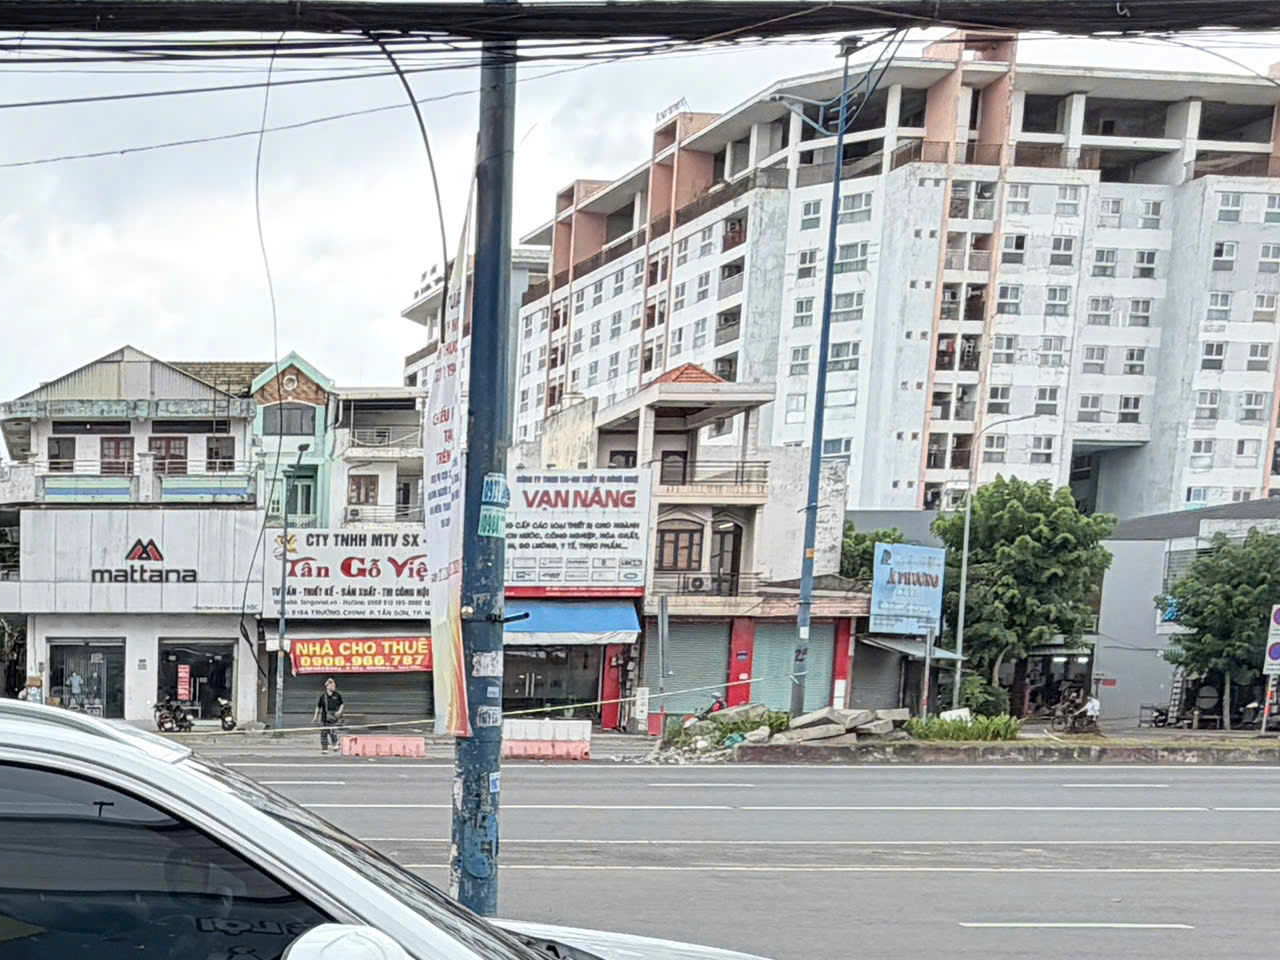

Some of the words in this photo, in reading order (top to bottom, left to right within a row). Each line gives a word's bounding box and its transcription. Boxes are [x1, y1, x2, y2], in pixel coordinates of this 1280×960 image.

[522, 490, 569, 511] VẠN
[573, 487, 637, 508] NĂNG
[306, 533, 329, 547] CTY
[334, 533, 367, 547] TNHH
[371, 533, 398, 547] MTV
[402, 533, 419, 547] SX
[91, 564, 197, 583] mattana
[284, 556, 330, 578] Tân
[340, 557, 381, 578] Gỗ
[387, 554, 428, 581] Việ
[304, 585, 322, 596] THIẾT
[324, 585, 335, 596] KẾ
[341, 585, 357, 596] SẢN
[359, 585, 376, 596] XUẤT
[382, 587, 393, 597] THI
[395, 586, 414, 597] CÔNG
[416, 586, 429, 598] NỘI
[296, 639, 334, 656] NHÀ
[339, 641, 377, 655] CHO
[381, 637, 429, 654] THUÊ
